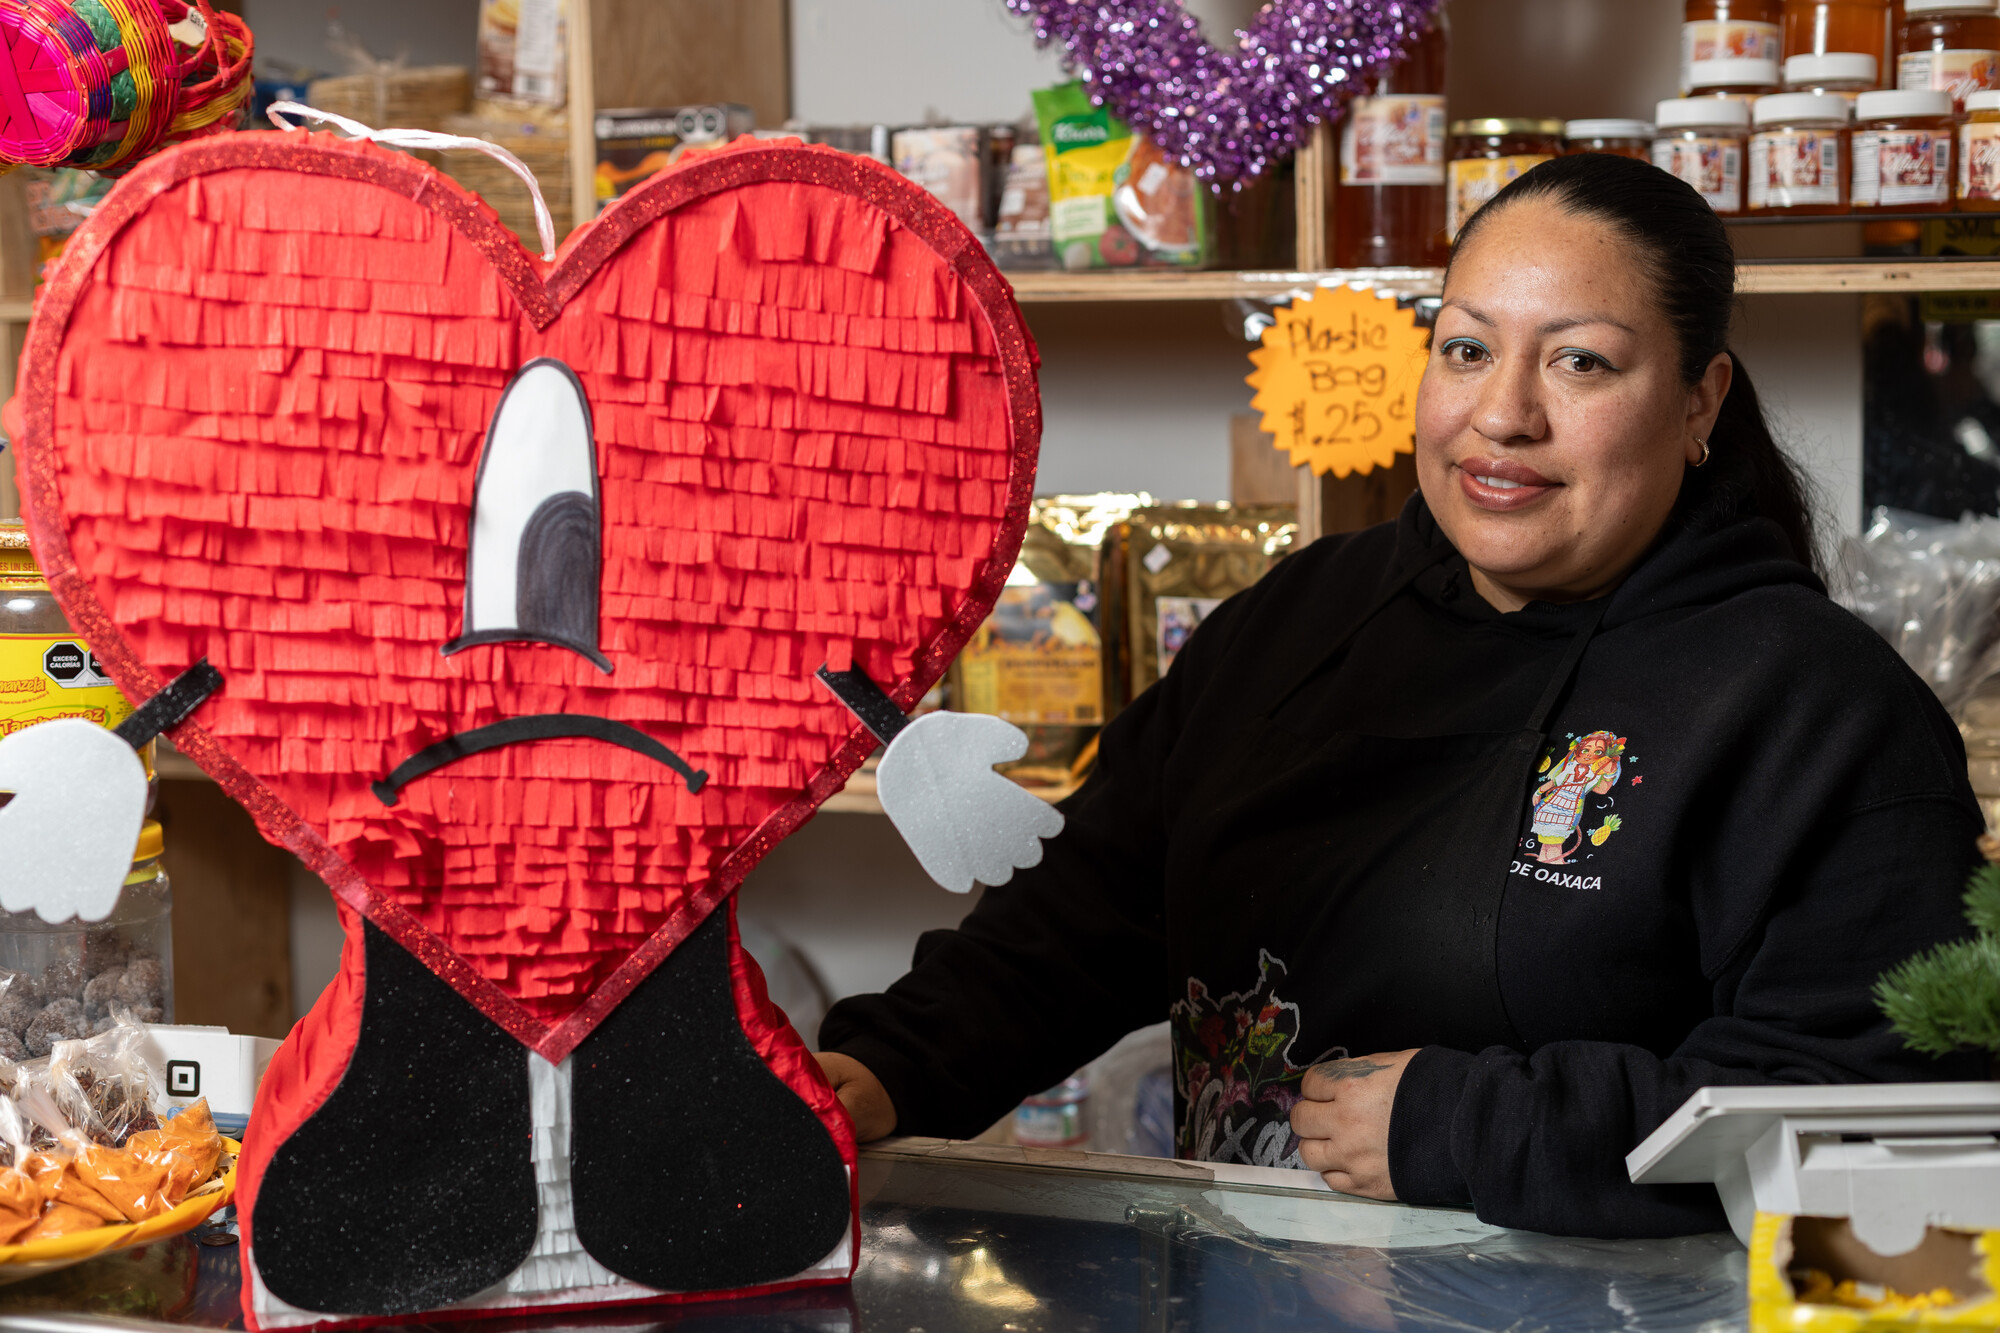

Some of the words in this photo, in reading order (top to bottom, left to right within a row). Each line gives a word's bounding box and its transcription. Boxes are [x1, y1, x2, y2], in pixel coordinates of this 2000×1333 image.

[1303, 361, 1387, 397] Bag
[1510, 860, 1534, 876] DE
[1534, 868, 1602, 890] OAXACA
